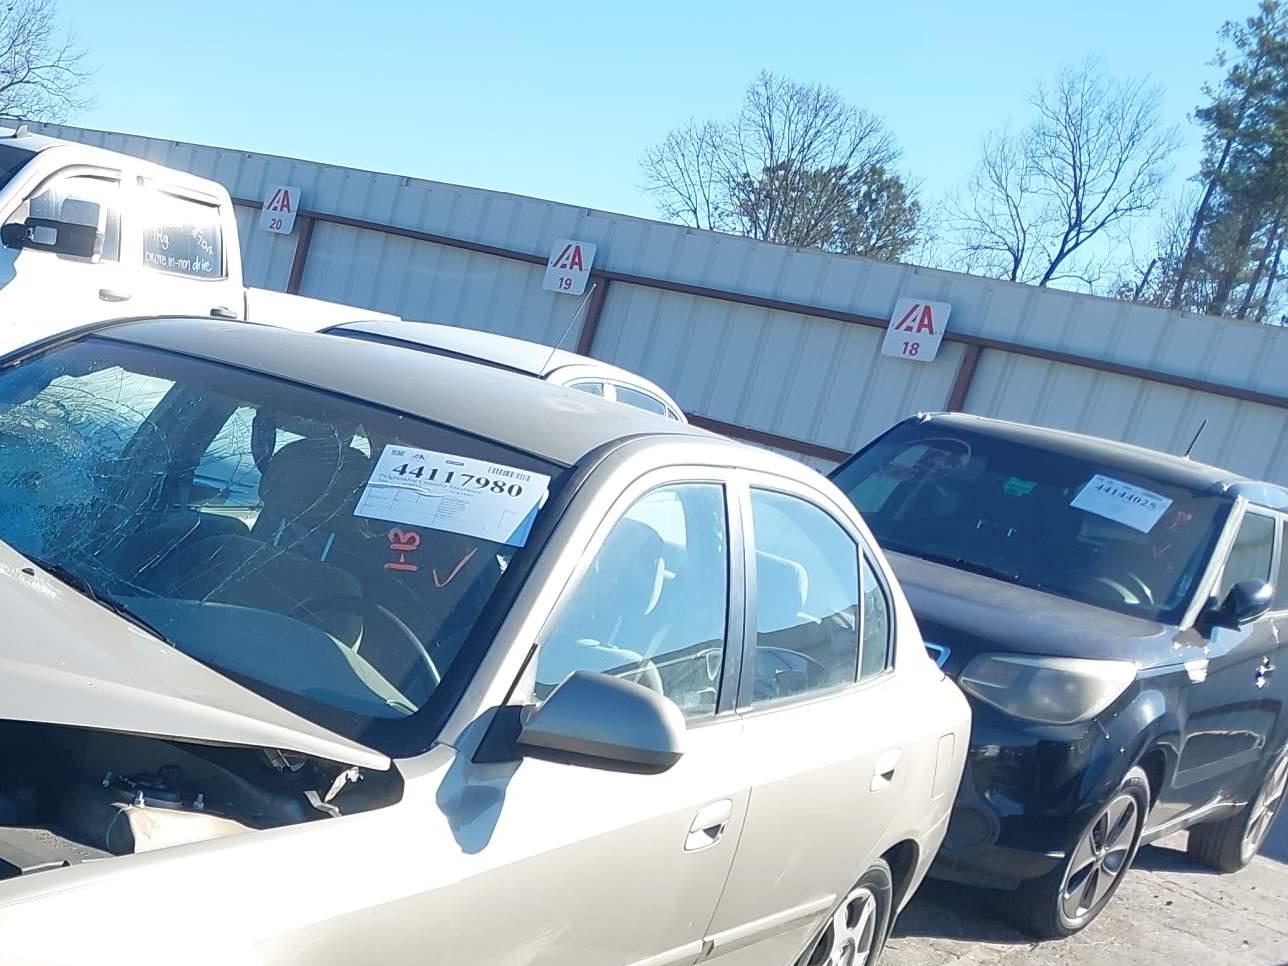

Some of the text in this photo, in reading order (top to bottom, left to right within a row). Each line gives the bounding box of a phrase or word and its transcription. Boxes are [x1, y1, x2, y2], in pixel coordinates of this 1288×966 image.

[269, 217, 282, 230] 20
[558, 276, 572, 290] 19
[902, 341, 920, 356] 18
[392, 463, 523, 498] 44117980
